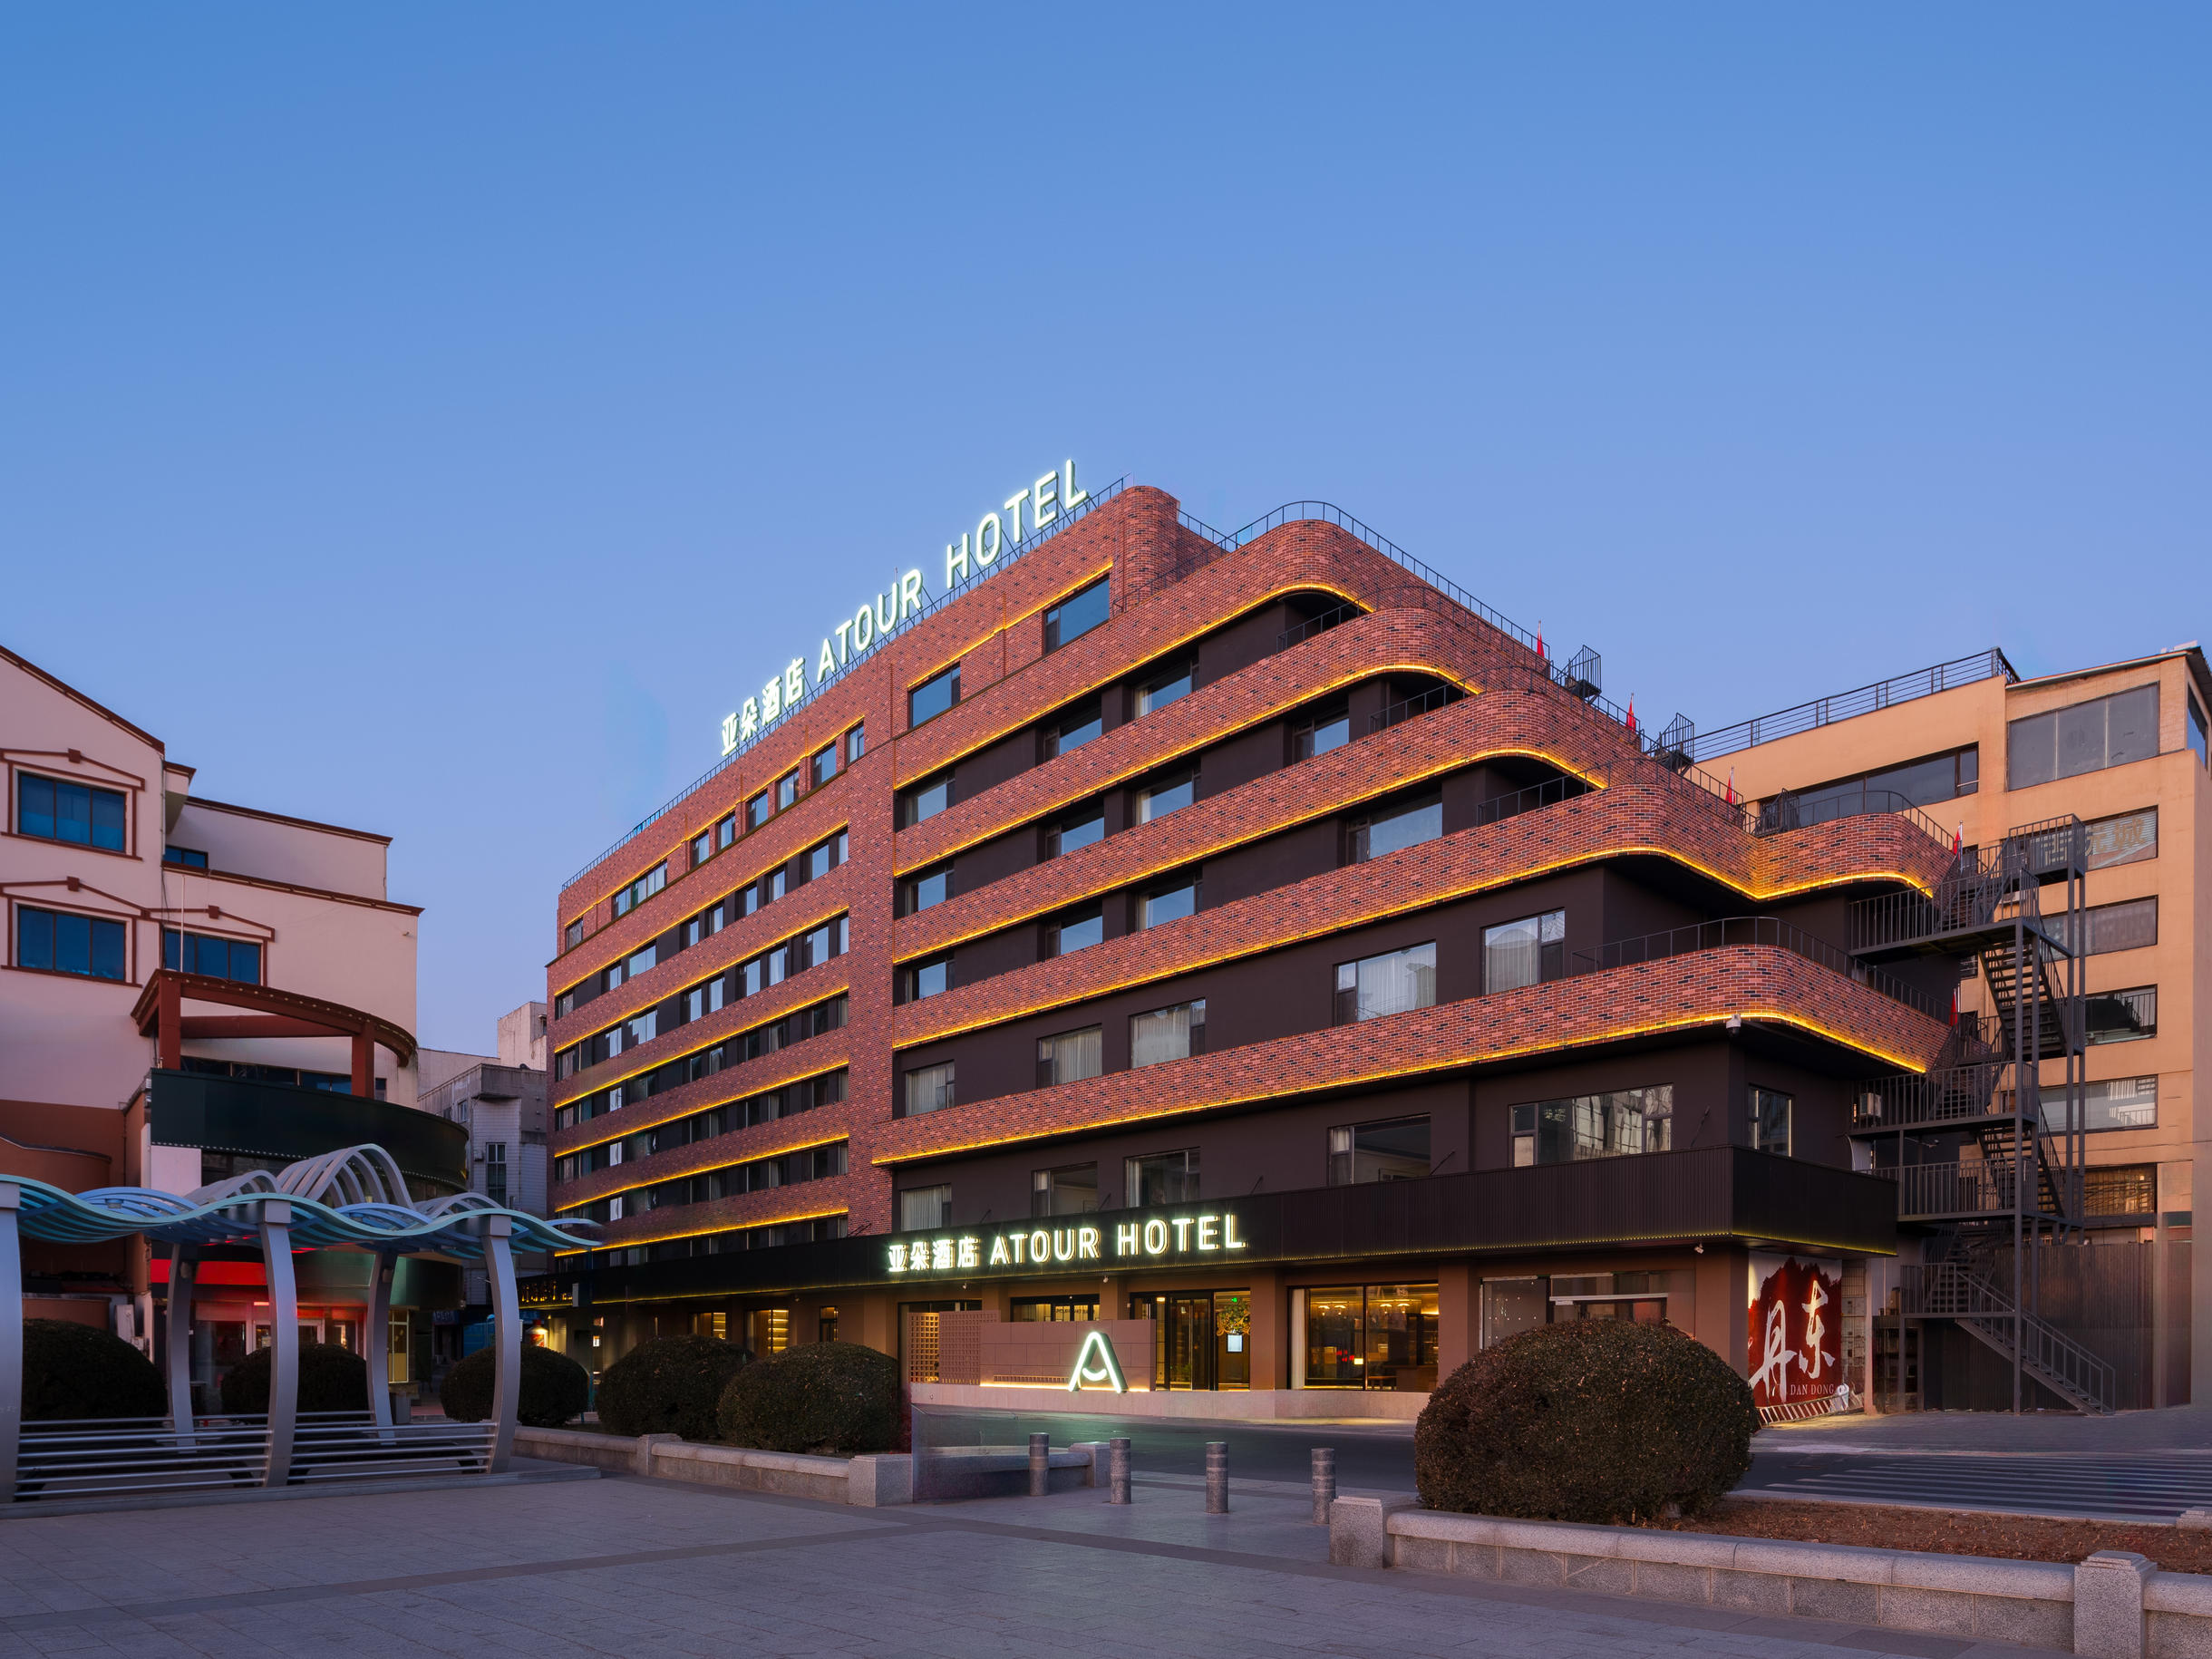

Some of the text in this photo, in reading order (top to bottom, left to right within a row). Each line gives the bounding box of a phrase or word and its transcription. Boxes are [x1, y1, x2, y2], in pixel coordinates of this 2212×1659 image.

[817, 459, 1088, 683] ATOUR HOTEL
[722, 656, 806, 756] 亚朵酒店
[888, 1236, 980, 1272] 亚朵酒店
[990, 1214, 1247, 1265] ATOUR HOTEL
[1790, 1383, 1834, 1395] DAN DONG
